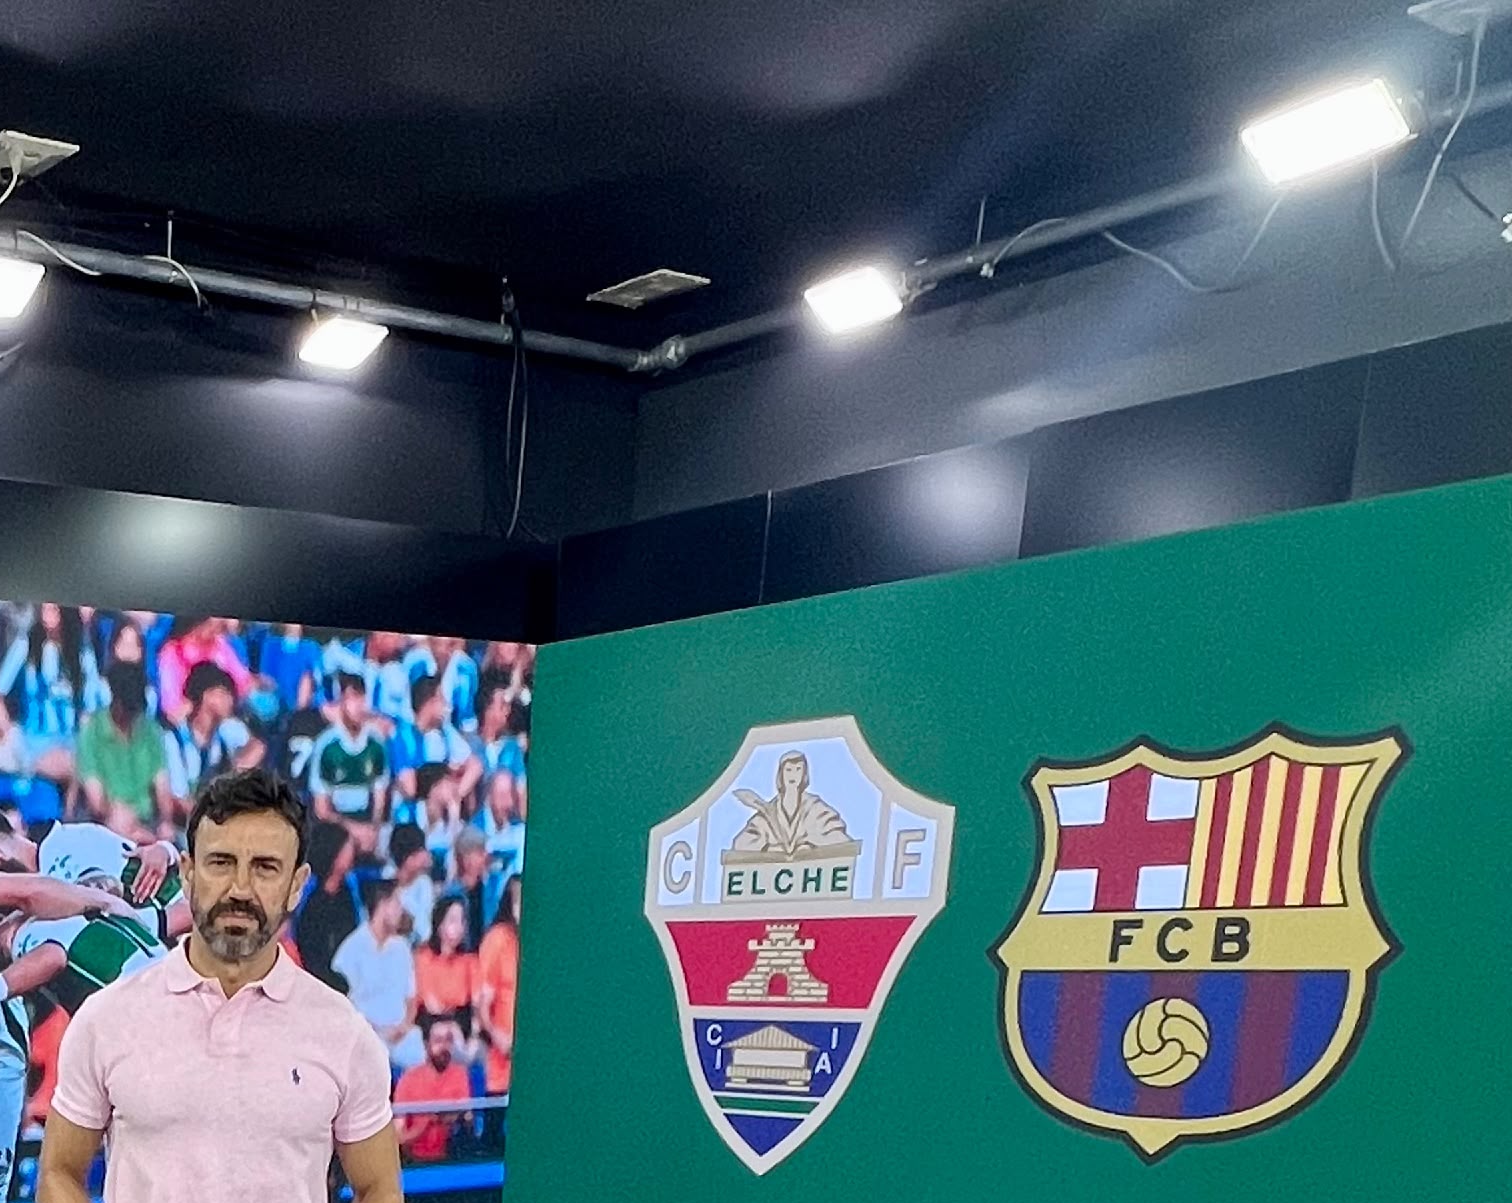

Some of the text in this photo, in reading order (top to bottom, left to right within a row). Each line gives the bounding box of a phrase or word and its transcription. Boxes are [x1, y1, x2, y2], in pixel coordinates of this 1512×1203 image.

[663, 841, 693, 894] C
[891, 829, 926, 890] F
[727, 866, 850, 896] ELCHE
[1108, 917, 1250, 963] FCB
[706, 1023, 723, 1046] C
[814, 1052, 832, 1074] A
